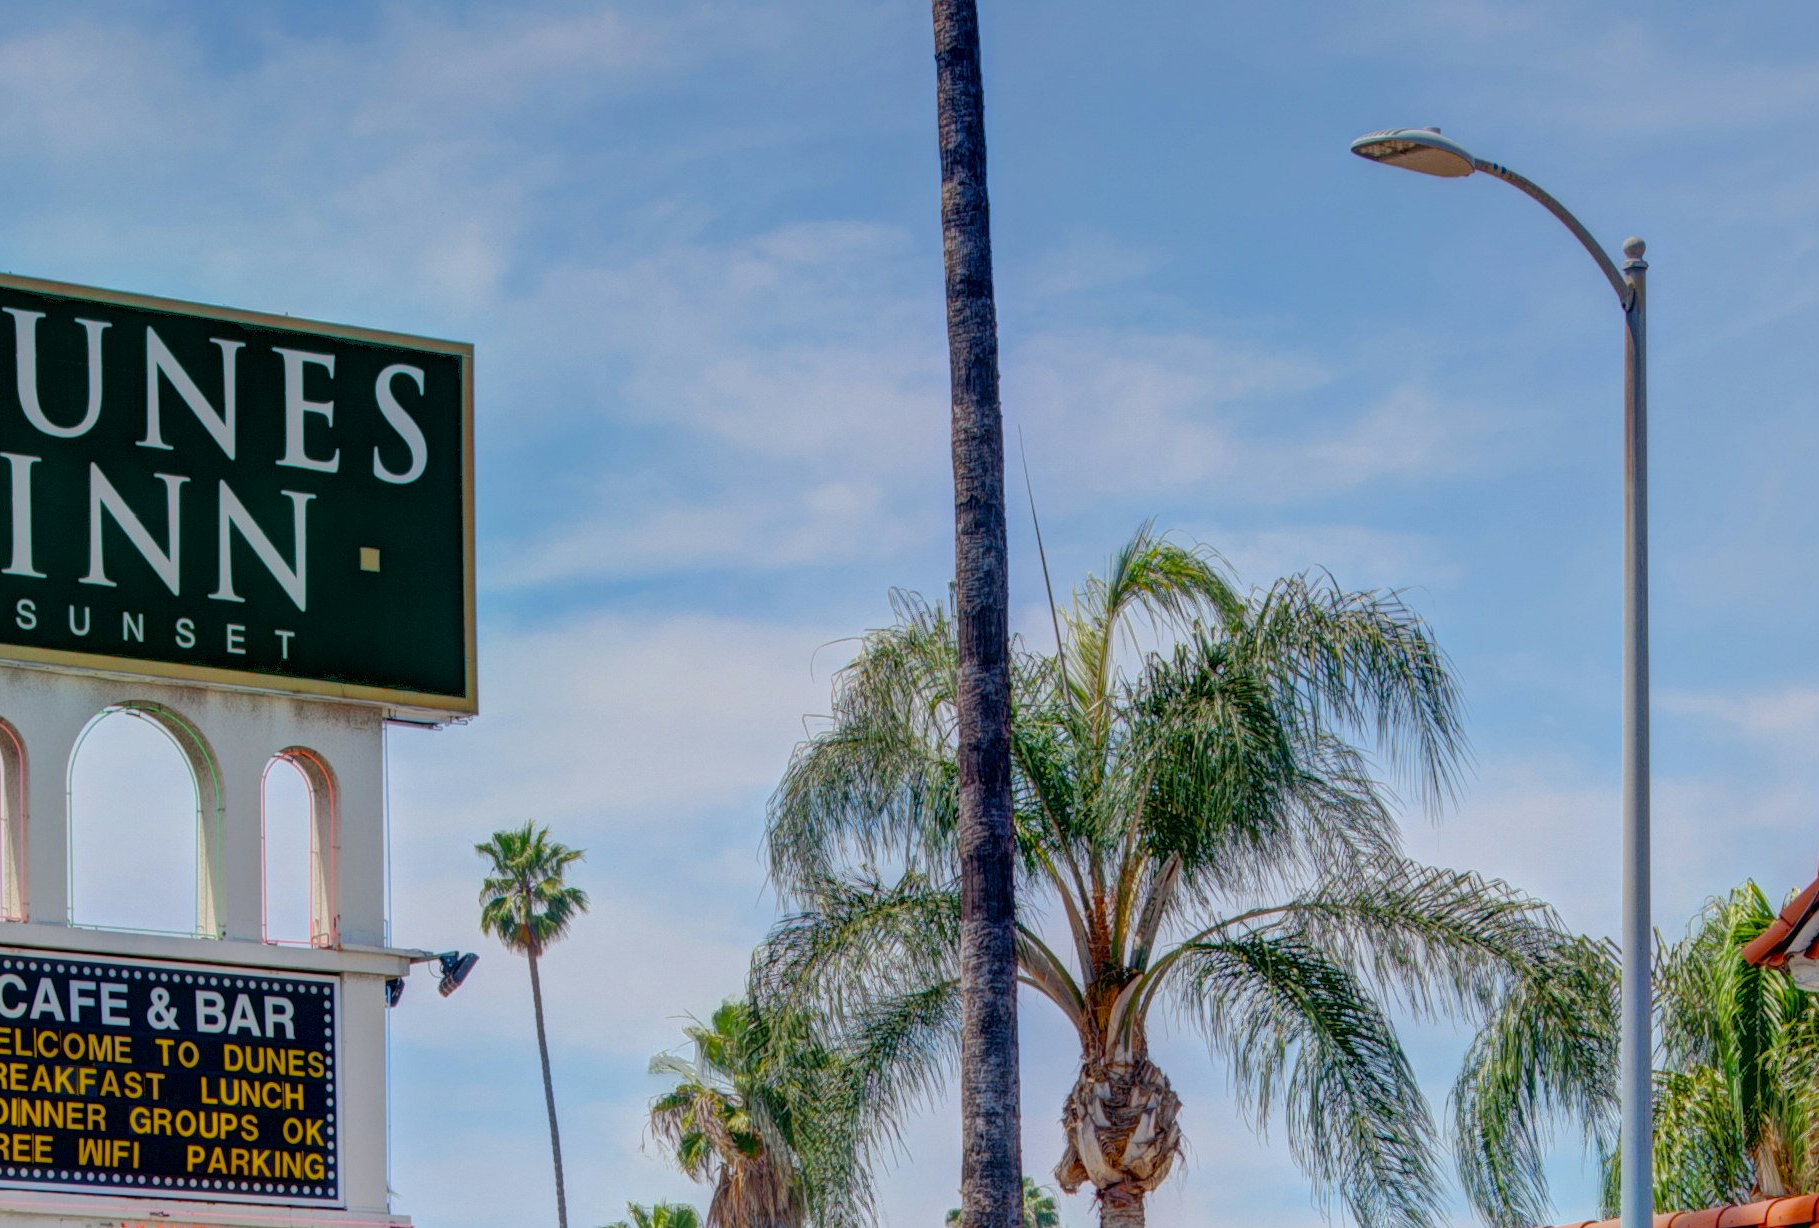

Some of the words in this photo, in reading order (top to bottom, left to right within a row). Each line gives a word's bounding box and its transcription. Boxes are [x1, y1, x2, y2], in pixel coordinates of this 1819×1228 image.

[0, 452, 317, 612] INN
[15, 598, 296, 660] SUNSET
[146, 986, 180, 1031] &
[195, 989, 296, 1040] BAR
[155, 1039, 200, 1069] TO
[223, 1043, 325, 1079] DUNES
[201, 1076, 304, 1111] LUNCH
[130, 1105, 259, 1141] GROUPS
[283, 1117, 325, 1147] OK
[79, 1138, 140, 1169] WIFI
[187, 1144, 325, 1181] PARKING
